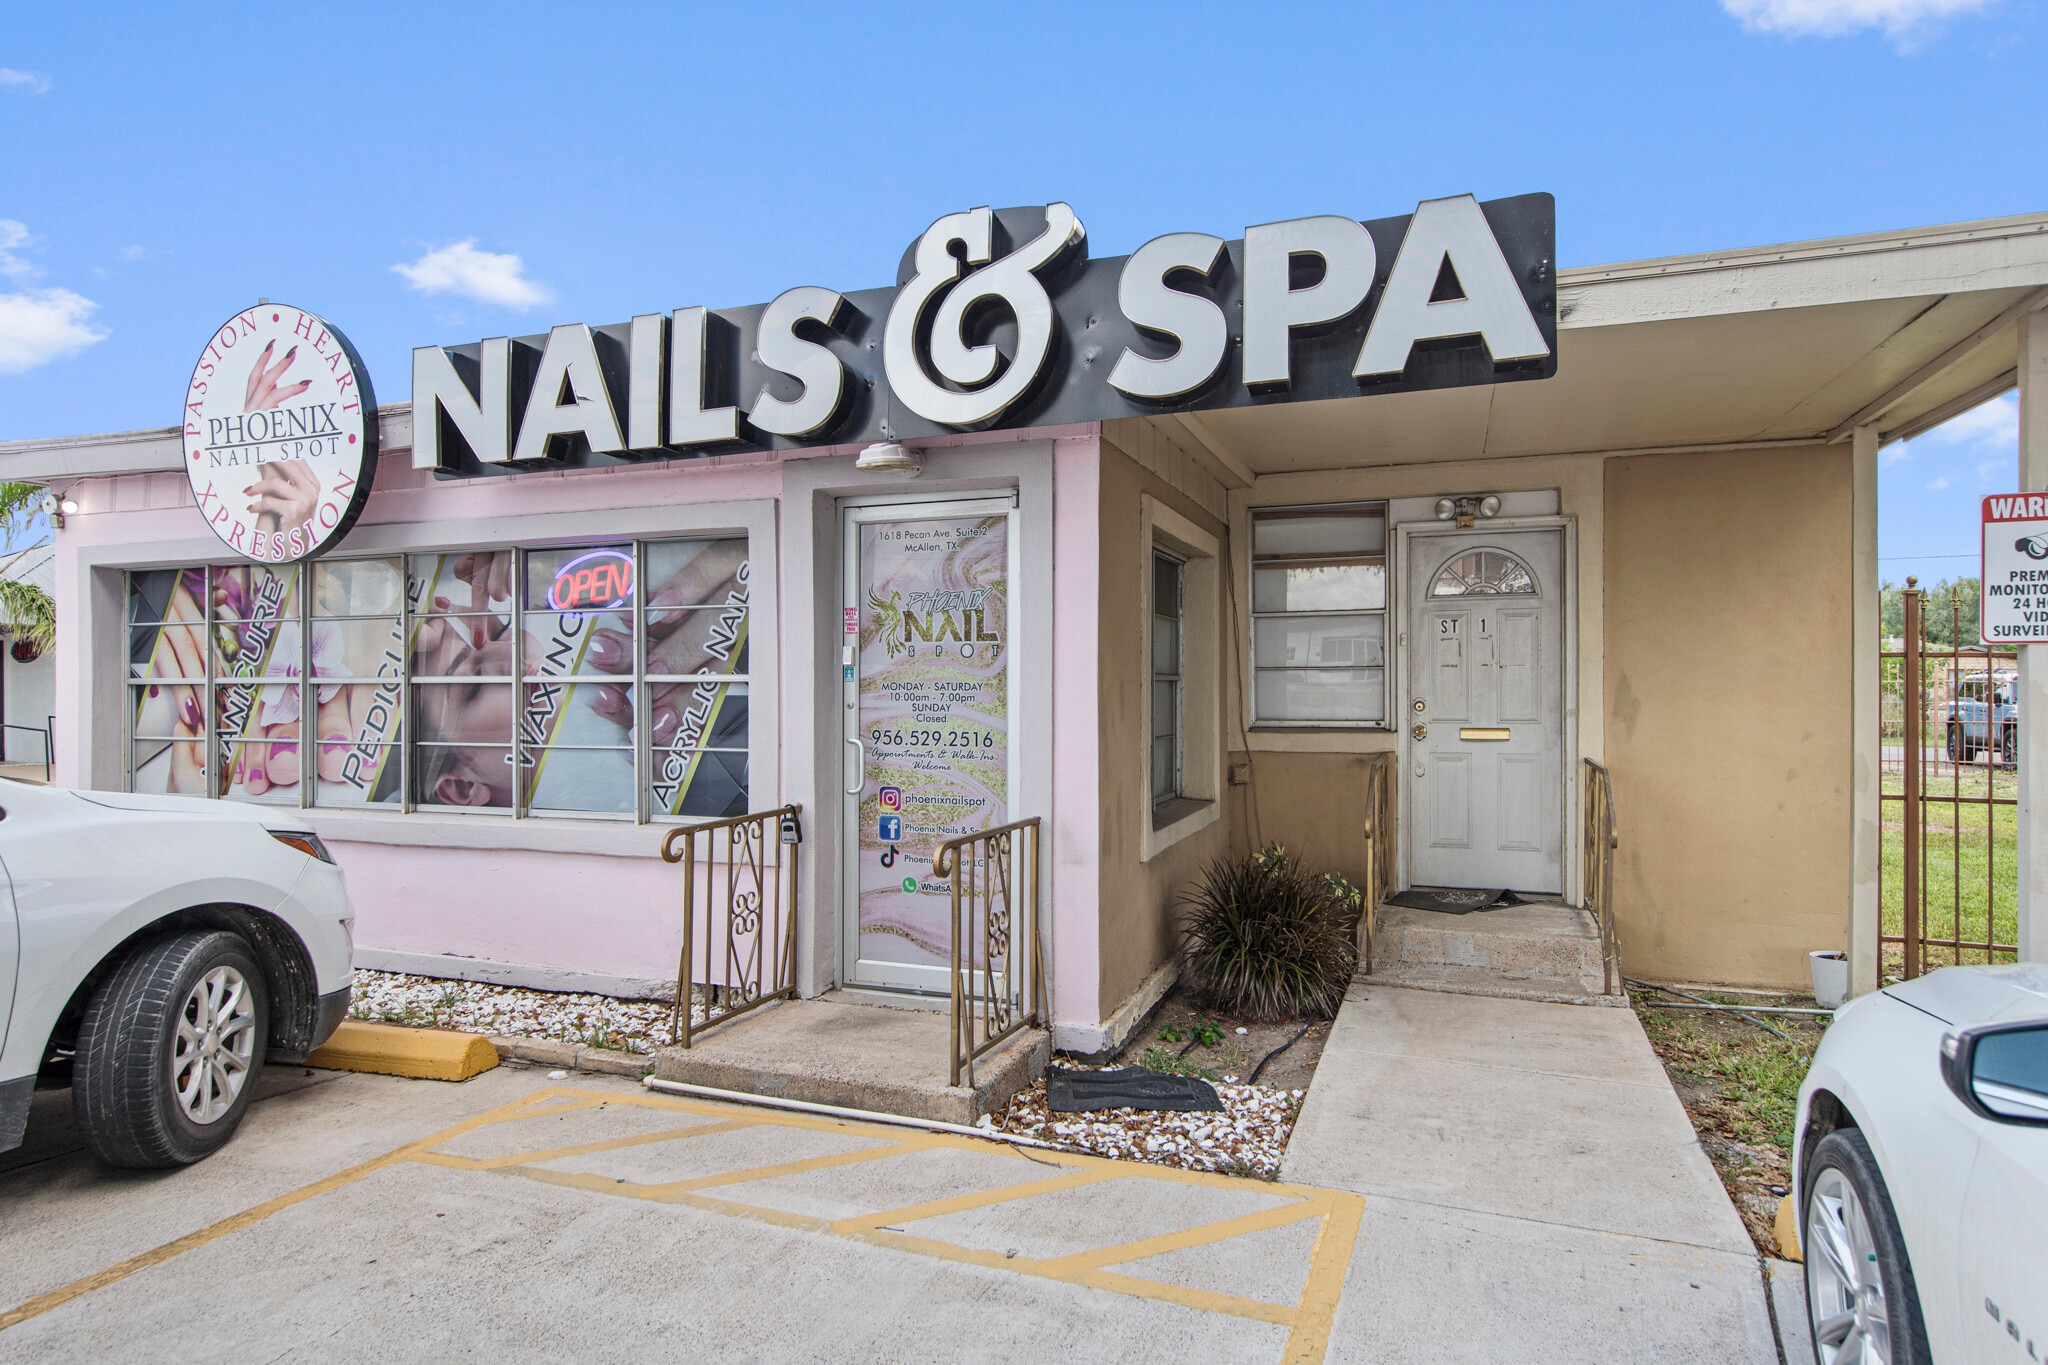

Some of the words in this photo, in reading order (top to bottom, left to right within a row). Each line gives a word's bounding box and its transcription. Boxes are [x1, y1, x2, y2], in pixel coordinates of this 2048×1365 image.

[412, 285, 852, 470] NAILS
[883, 202, 1082, 427] &
[1106, 193, 1550, 399] SPA
[294, 312, 361, 416] HEART
[186, 311, 258, 437] PASSION
[208, 402, 340, 446] PHOENIX
[209, 446, 266, 468] NAIL
[281, 437, 340, 461] SPOT
[196, 469, 356, 560] XPRESSION
[879, 531, 902, 540] 1618
[904, 530, 931, 539] Pecan
[933, 529, 953, 538] Ave.
[956, 527, 979, 537] Suite
[981, 526, 988, 536] 2
[904, 542, 943, 552] McAllen,
[946, 541, 960, 551] TX.
[553, 561, 631, 609] OPEN
[906, 587, 993, 615] PHOENIX
[2013, 598, 2031, 609] 24
[2036, 597, 2048, 609] H
[902, 608, 999, 643] NAIL
[1440, 619, 1459, 634] ST
[1480, 618, 1486, 633] 1
[1993, 625, 2048, 637] SURVEI
[908, 643, 999, 658] SPOT
[201, 576, 284, 775] ANICURE
[507, 612, 583, 766] WAXING
[881, 682, 925, 691] MONDAY
[934, 682, 984, 692] SATURDAY
[889, 692, 930, 702] 10:00am
[940, 692, 976, 704] 7:00pm
[911, 703, 952, 712] SUNDAY
[916, 714, 947, 723] Closed
[653, 669, 719, 810] ACRYLIC
[871, 729, 993, 748] 956.529.2516
[871, 747, 935, 761] Appointments
[950, 750, 995, 761] Walk-Ins
[912, 760, 952, 770] Welcome
[904, 793, 986, 808] phoenixnailspot
[904, 823, 936, 833] Phoenix
[938, 826, 959, 834] Nails
[961, 826, 968, 834] &
[920, 883, 952, 893] WhatsA
